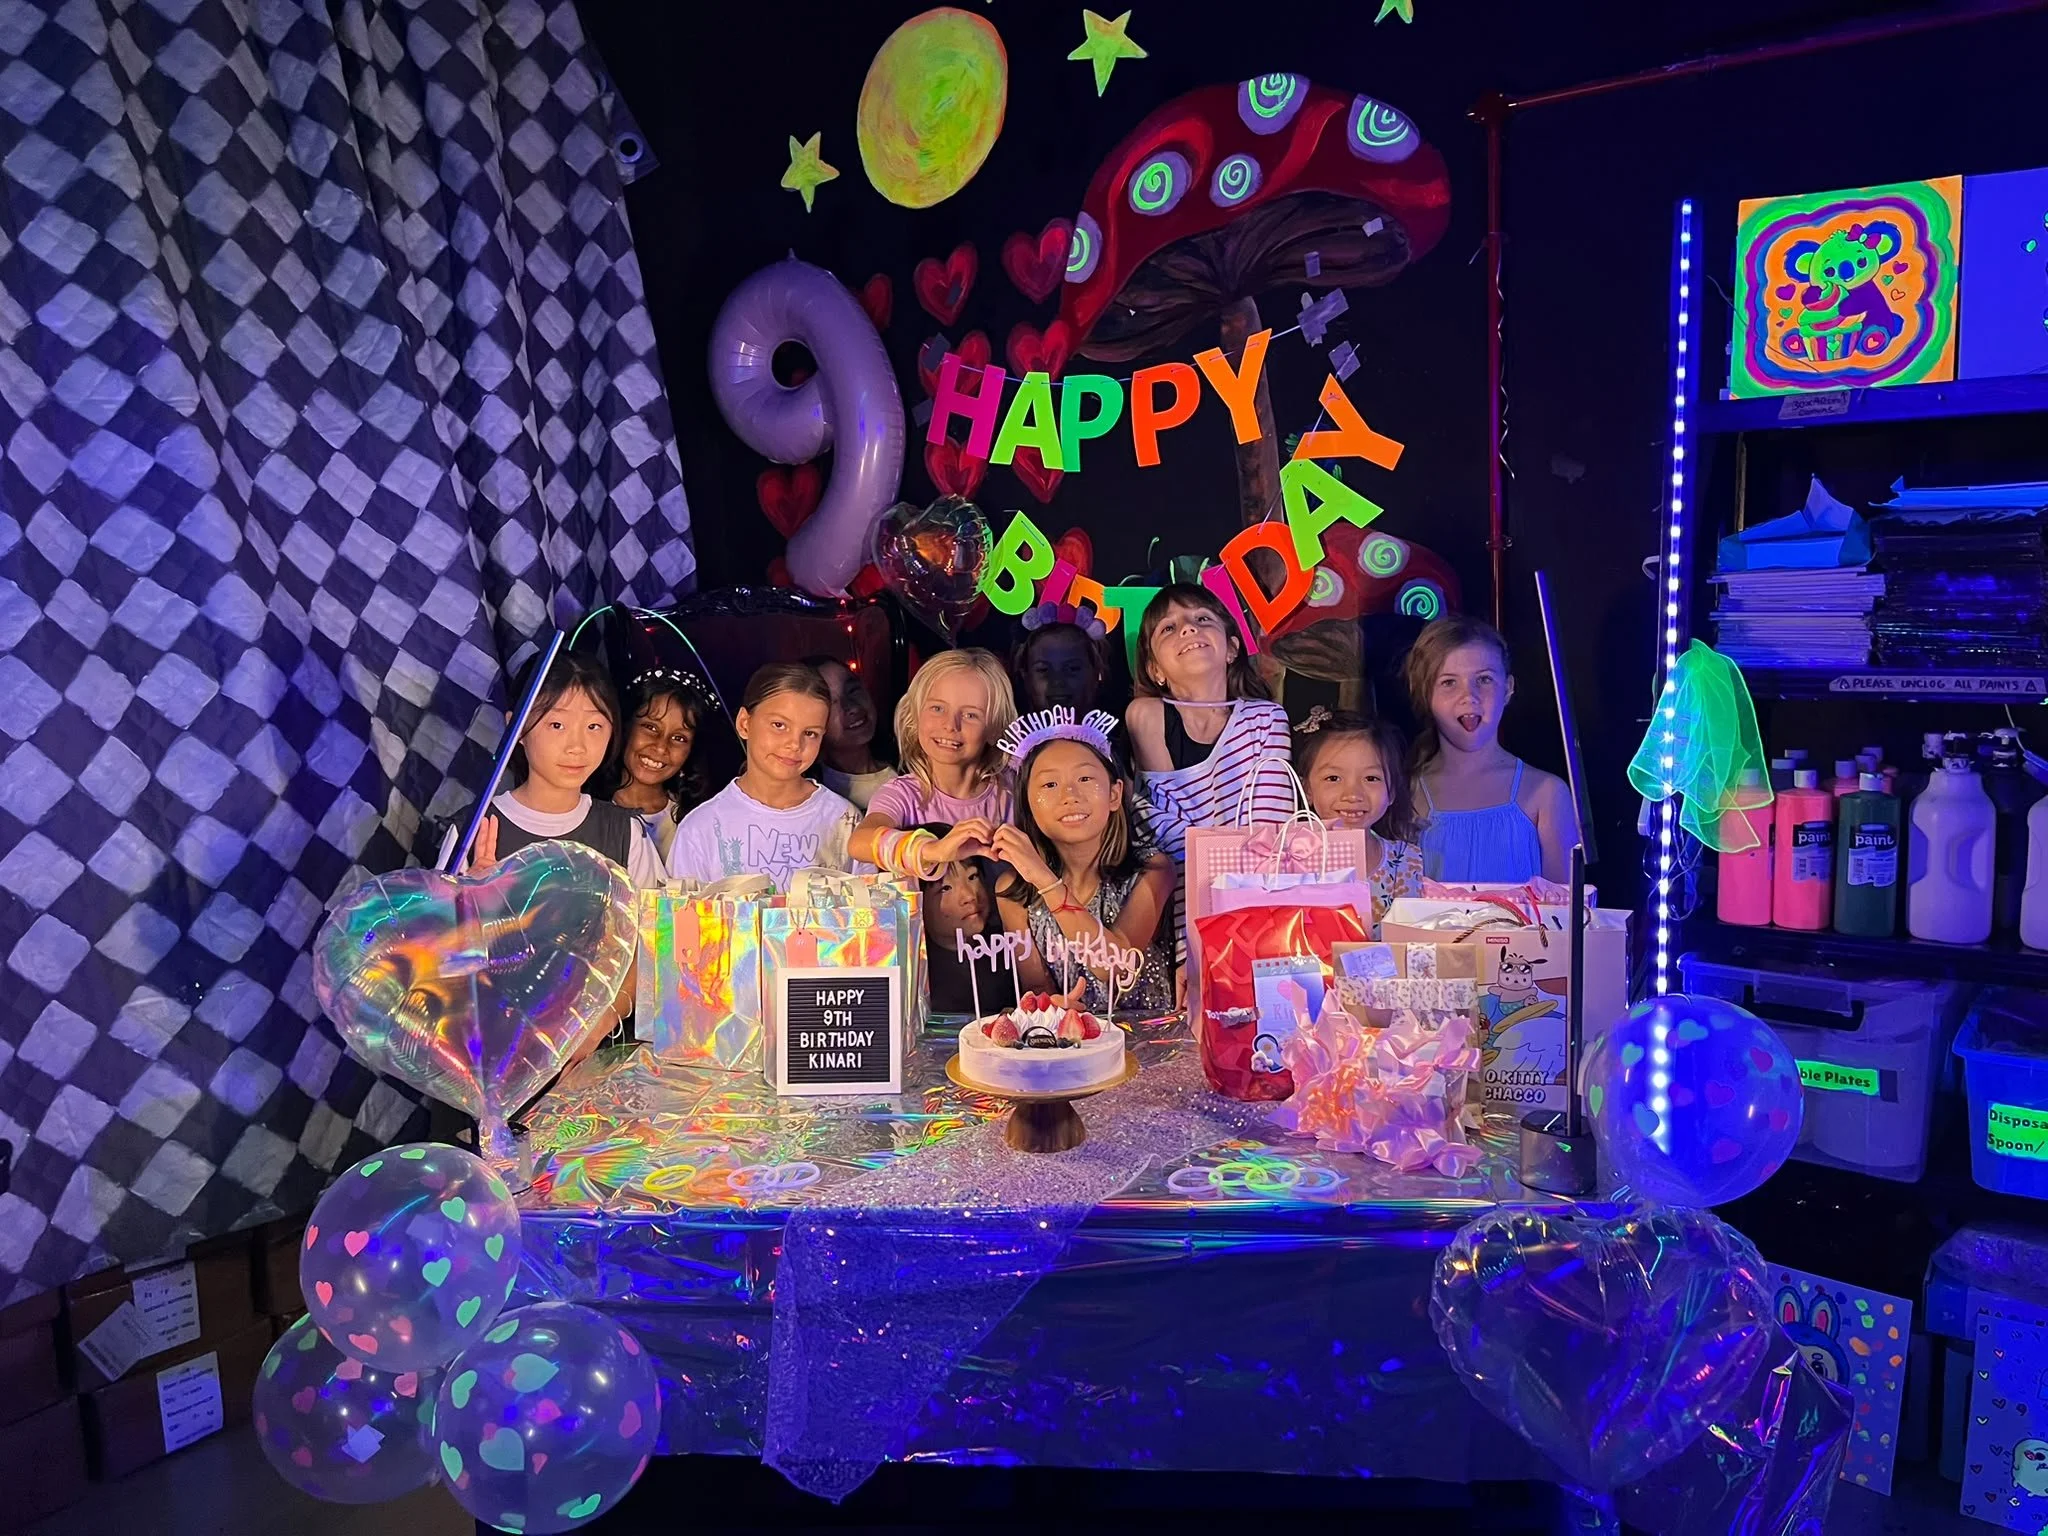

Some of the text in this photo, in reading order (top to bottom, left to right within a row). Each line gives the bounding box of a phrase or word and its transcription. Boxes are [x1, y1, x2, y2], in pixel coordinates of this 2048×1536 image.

[926, 328, 1272, 472] HAPPY
[708, 252, 906, 599] 9
[1852, 678, 2019, 690] PLEASE UNCLOG ALL PAINTS
[996, 704, 1119, 756] BIRTHDAY GIRL
[1854, 834, 1896, 847] paint
[955, 920, 1136, 986] happy birthday
[816, 989, 864, 1006] HAPPY
[823, 1009, 852, 1026] 9TH
[800, 1030, 874, 1048] BIRTHDAY
[809, 1052, 862, 1069] KINARI
[1500, 1070, 1549, 1086] KITTY
[1800, 1067, 1871, 1088] ble Plates
[1485, 1086, 1546, 1103] CHACCO
[1990, 1109, 2048, 1129] Disposa
